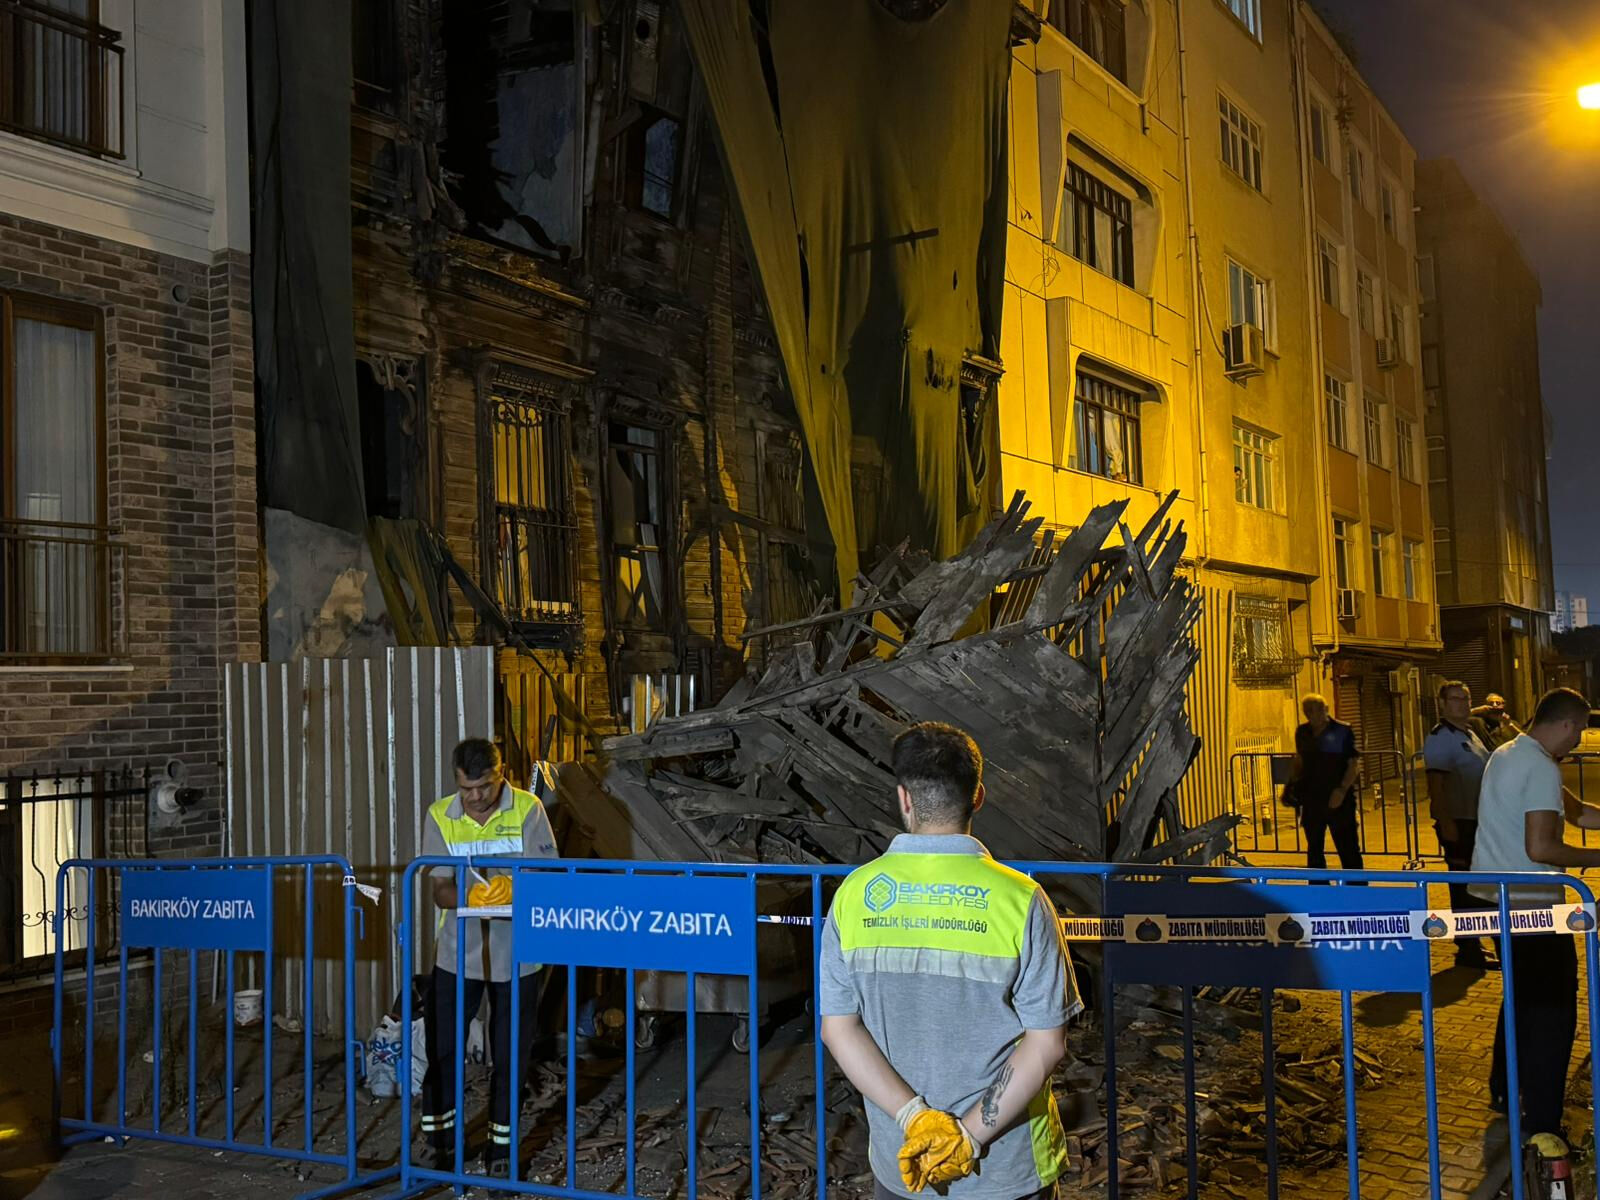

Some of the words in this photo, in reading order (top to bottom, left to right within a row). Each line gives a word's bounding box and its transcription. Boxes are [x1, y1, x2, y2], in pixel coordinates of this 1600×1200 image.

[131, 896, 200, 919] BAKIRKÖY
[203, 900, 255, 919] ZABITA
[531, 906, 643, 932] BAKIRKÖY
[649, 911, 732, 936] ZABITA
[931, 917, 988, 933] MÜDÜRLÜĞÜ
[1064, 919, 1124, 937] MÜDÜRLÜĞÜ
[1168, 922, 1203, 937] ZABITA
[1204, 919, 1266, 937] MÜDÜRLÜĞÜ
[1311, 920, 1346, 936] ZABITA
[1347, 916, 1410, 935] MÜDÜRLÜĞÜ
[1454, 916, 1488, 931] ZABITA
[1489, 910, 1554, 930] MÜRLÜĞÜ
